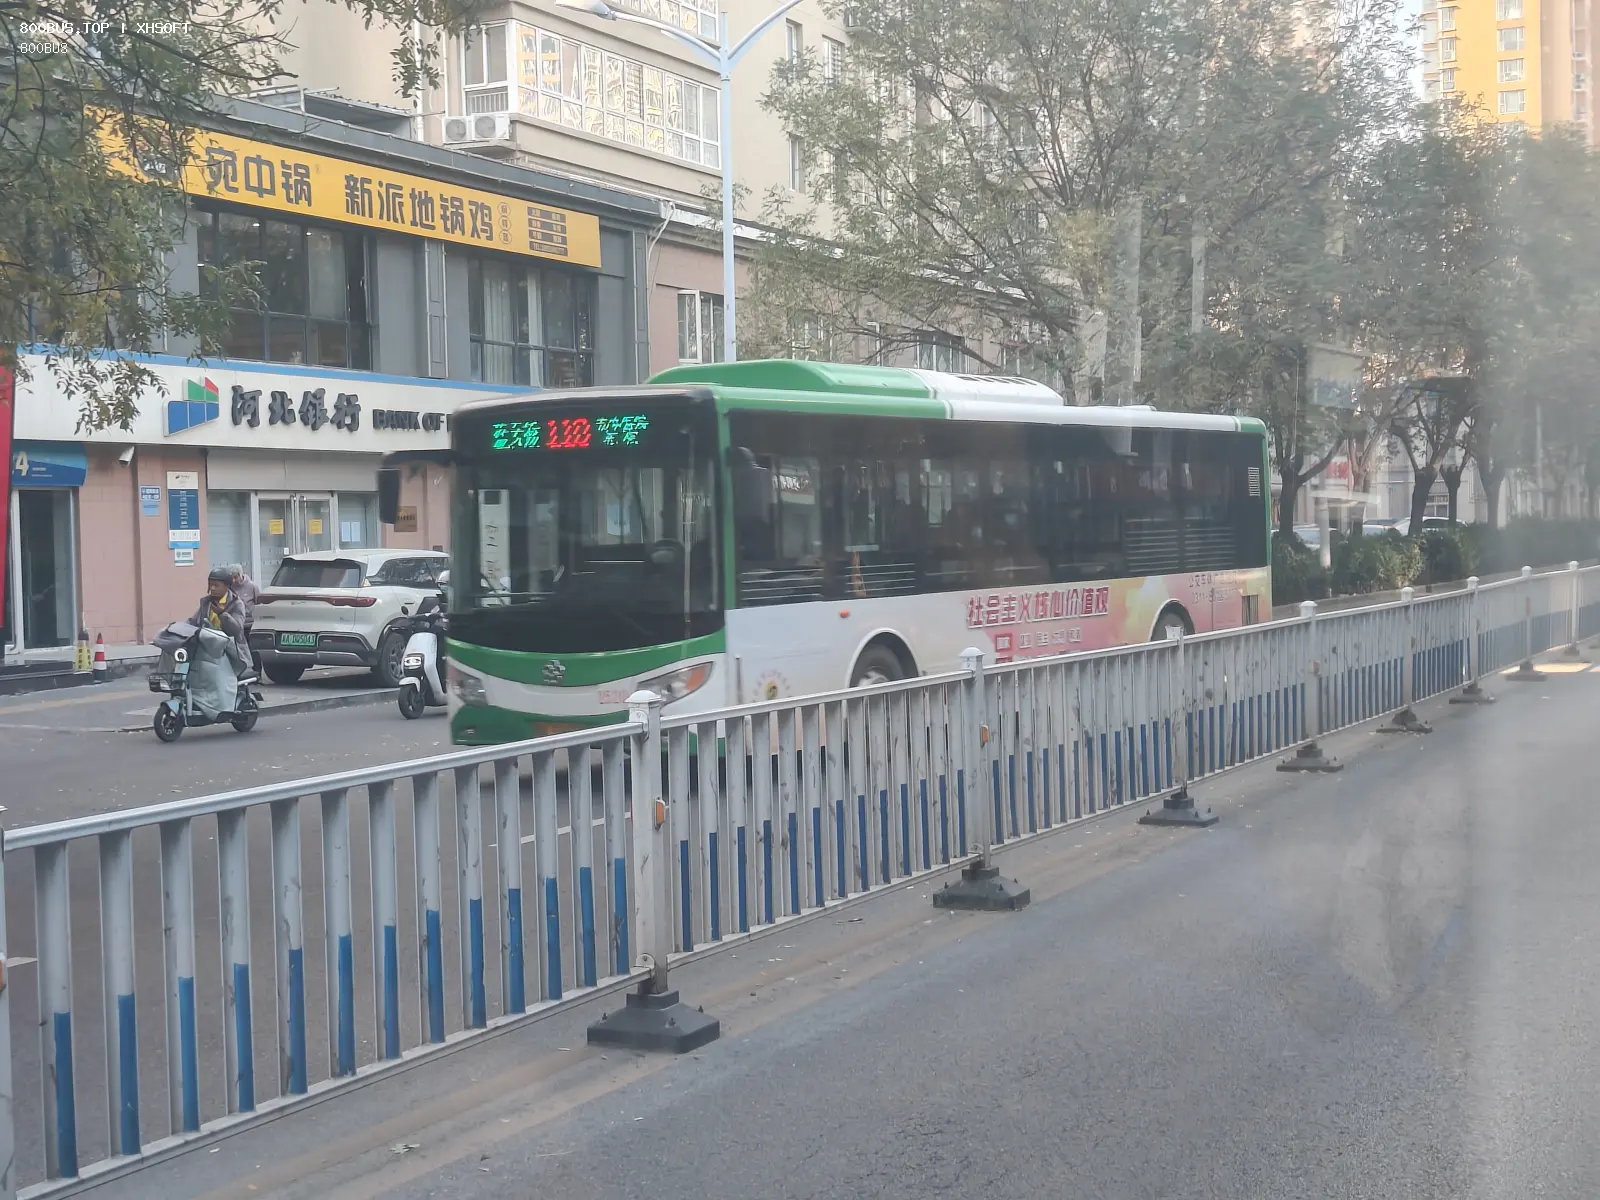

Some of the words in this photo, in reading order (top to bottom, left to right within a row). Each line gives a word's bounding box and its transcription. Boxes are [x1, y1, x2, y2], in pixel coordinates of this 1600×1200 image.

[343, 172, 494, 242] 新派地锅鸡
[230, 383, 362, 432] 河北银行
[372, 408, 421, 431] BANK
[421, 412, 446, 431] OF
[12, 450, 30, 477] 4
[967, 586, 1110, 629] 社会主义核心价值观
